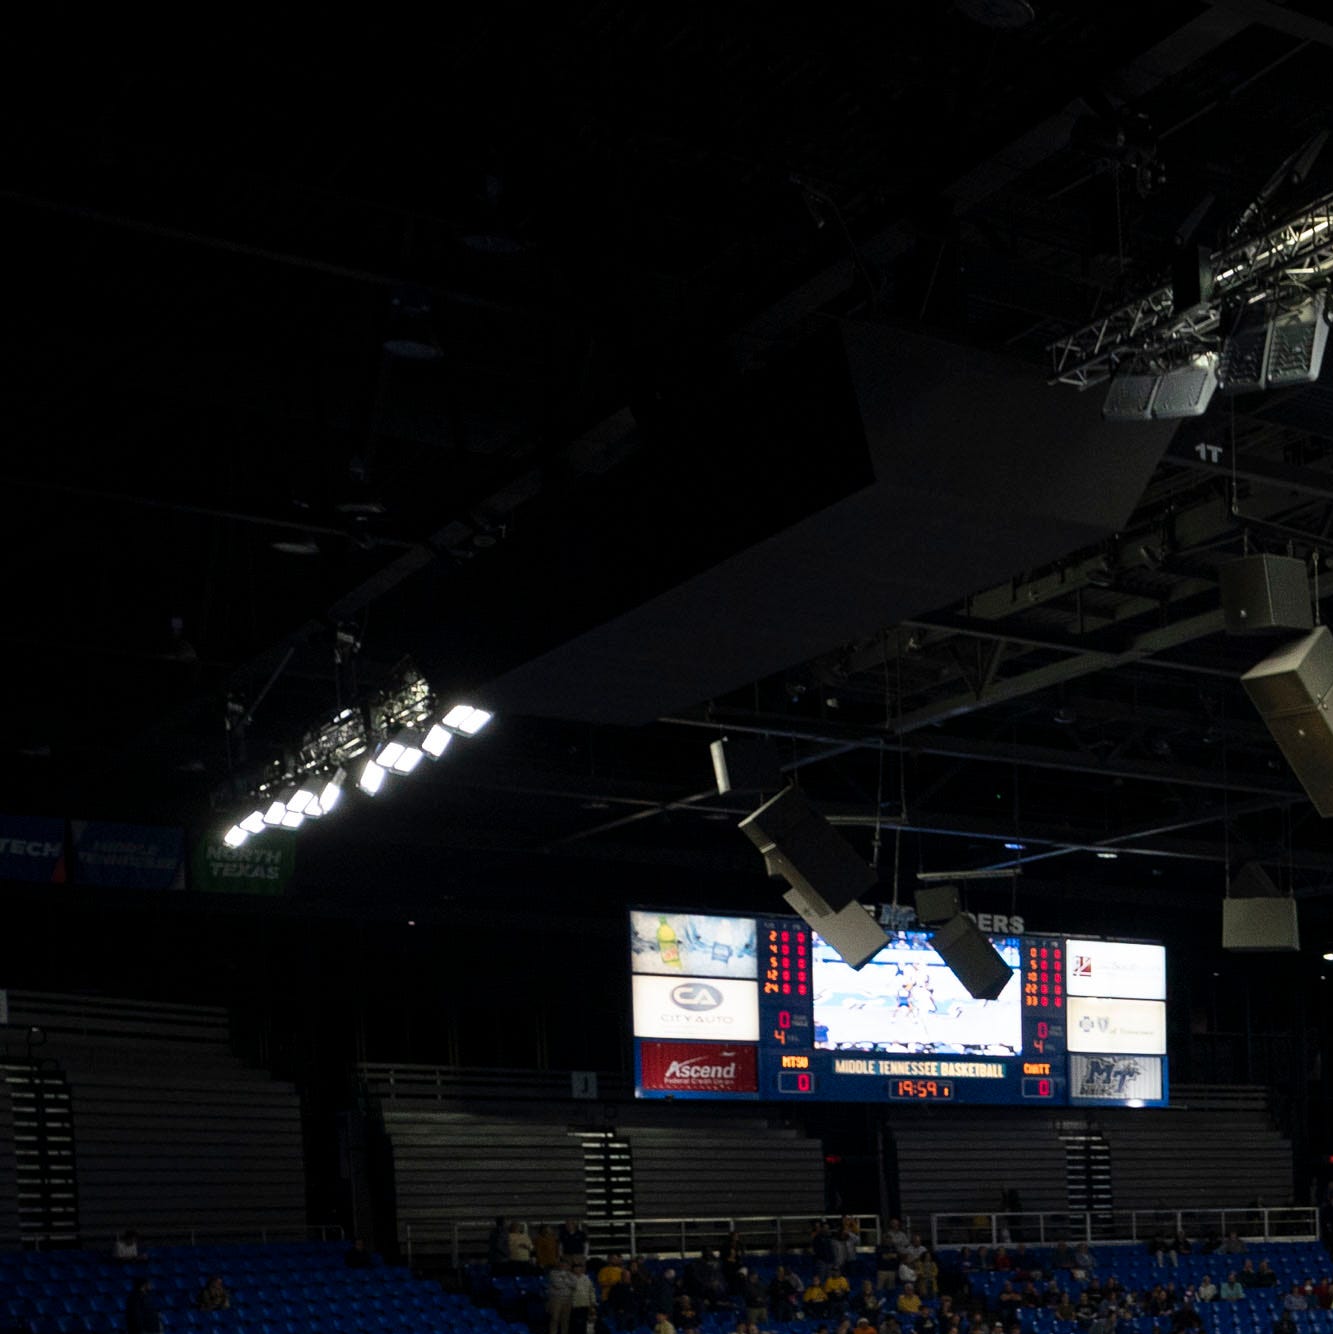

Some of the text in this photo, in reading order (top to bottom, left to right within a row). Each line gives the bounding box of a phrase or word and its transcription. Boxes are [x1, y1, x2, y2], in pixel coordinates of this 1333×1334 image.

[673, 986, 719, 1006] CA
[661, 1013, 735, 1025] CITY AUTO
[774, 1030, 787, 1045] 4
[665, 1059, 736, 1079] Ascend
[782, 1055, 809, 1068] MTSU
[835, 1059, 1005, 1079] MIDDLE TENNESSEE BASKETBALL
[1023, 1063, 1050, 1075] CHATT
[797, 1073, 810, 1092] 0
[898, 1081, 938, 1098] 19:59
[1038, 1079, 1050, 1096] 0
